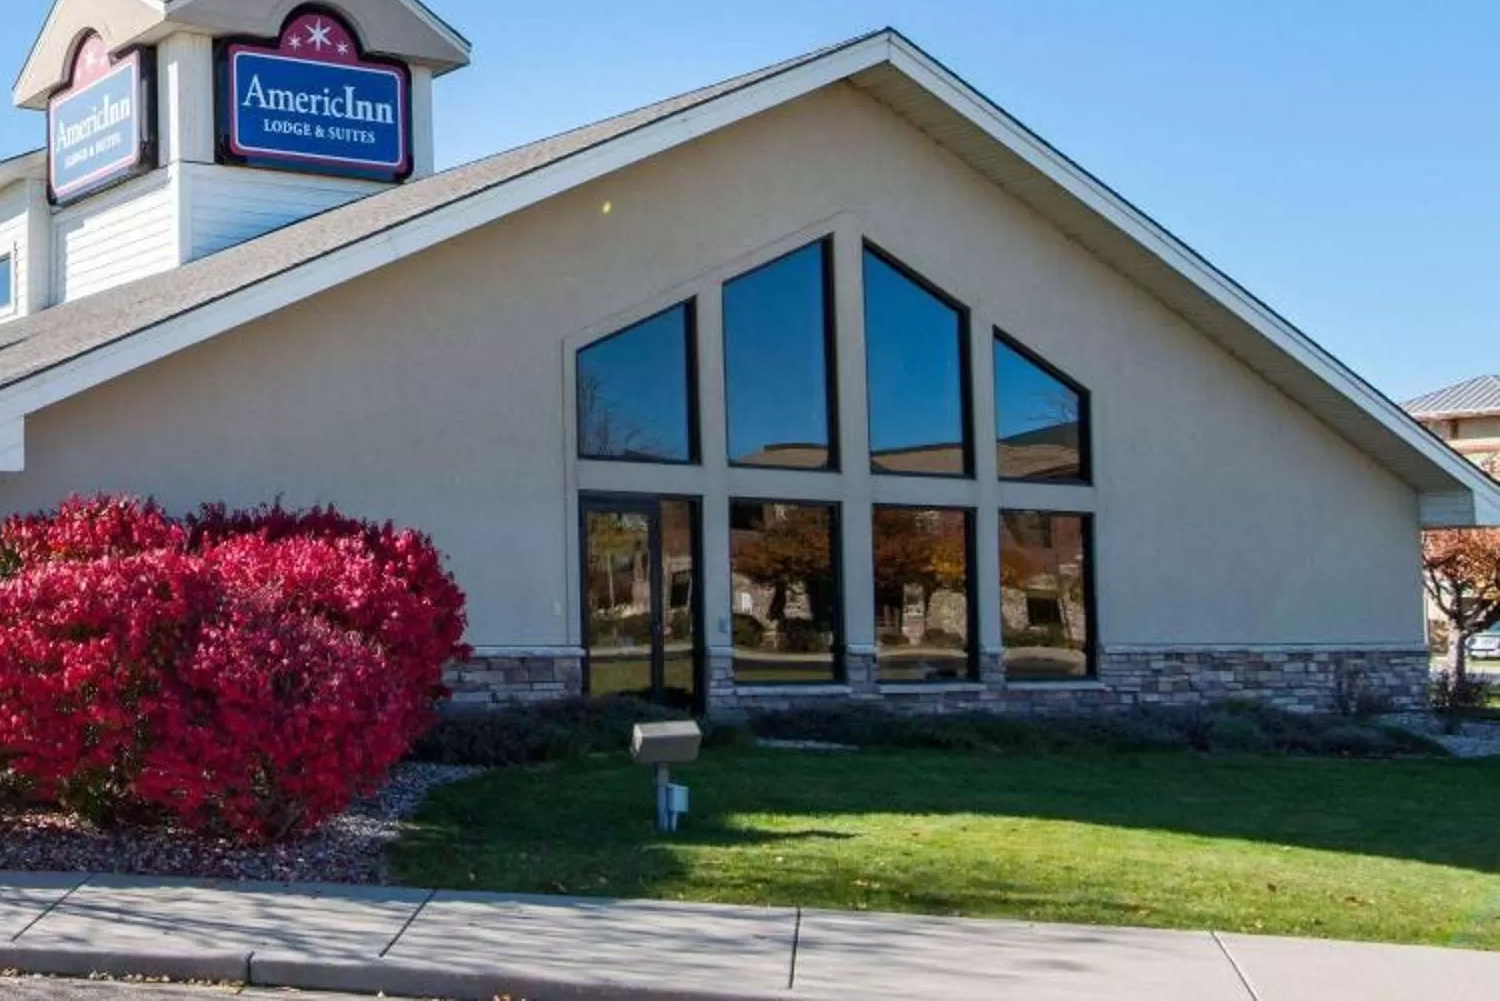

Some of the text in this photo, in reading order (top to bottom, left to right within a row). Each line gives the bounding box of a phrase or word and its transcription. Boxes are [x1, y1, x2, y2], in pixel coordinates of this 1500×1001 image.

[242, 74, 394, 124] AmericInn
[263, 118, 375, 144] LODGE & SUITES
